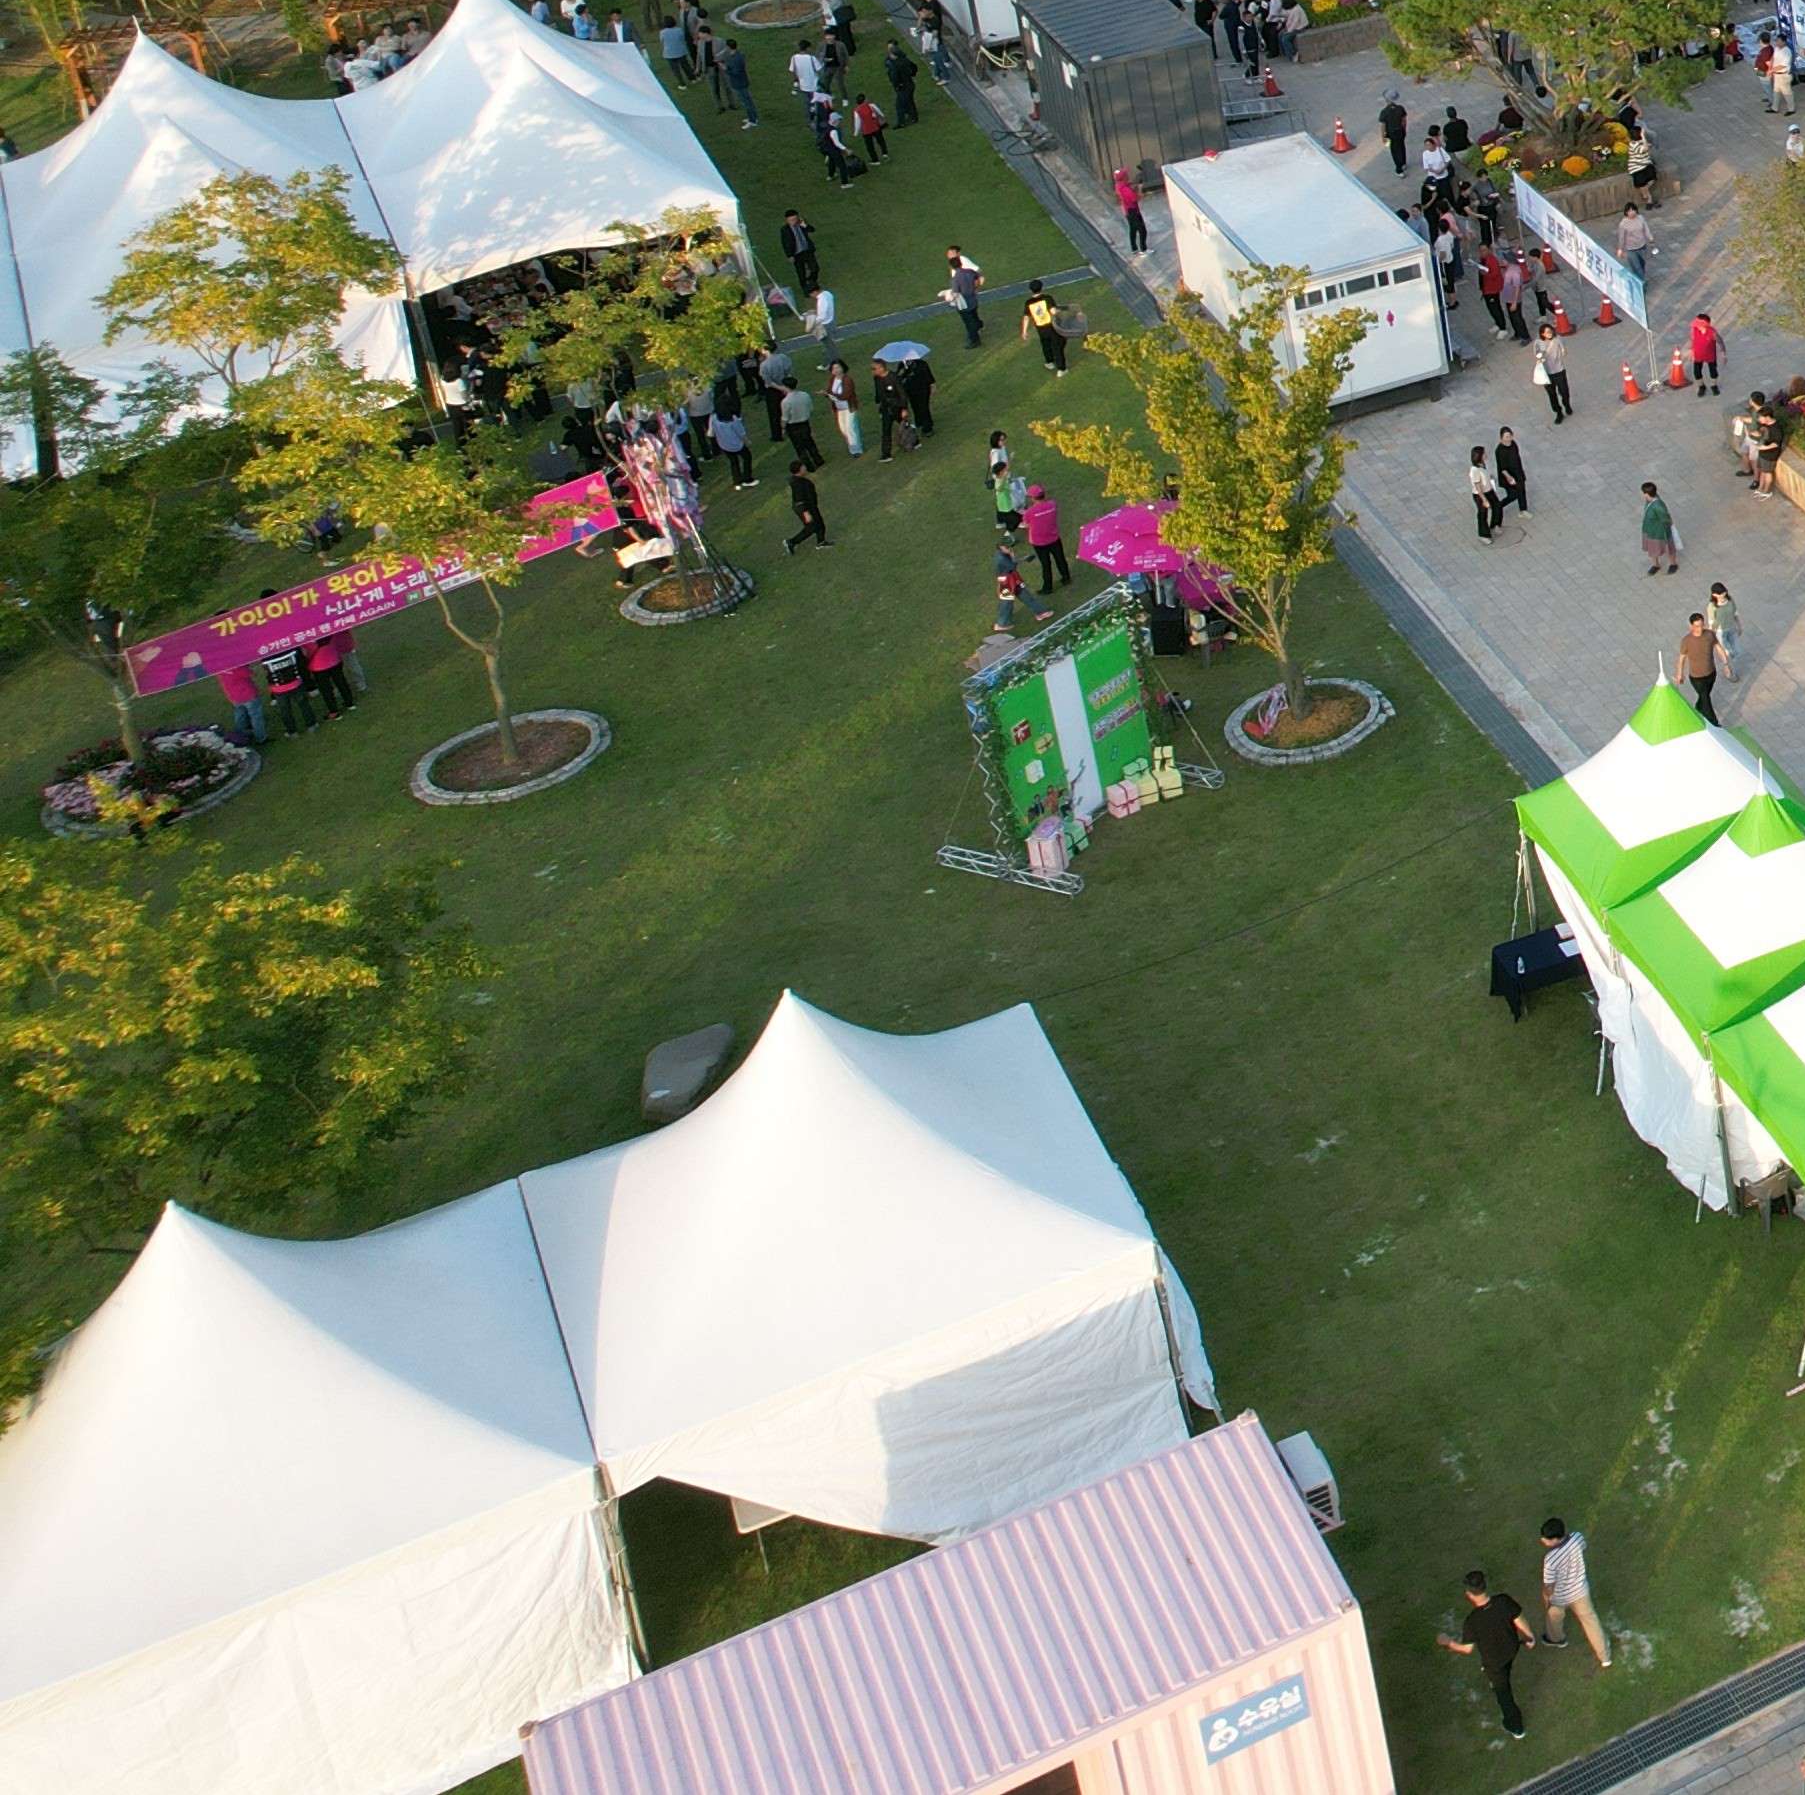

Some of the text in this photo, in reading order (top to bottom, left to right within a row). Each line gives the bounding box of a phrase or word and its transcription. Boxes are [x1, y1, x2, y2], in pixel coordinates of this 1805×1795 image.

[209, 587, 320, 637] 가인이가
[293, 627, 317, 643] 공식
[359, 600, 396, 620] AGAIN
[325, 586, 384, 616] 신나게
[1237, 1684, 1302, 1727] 수유실
